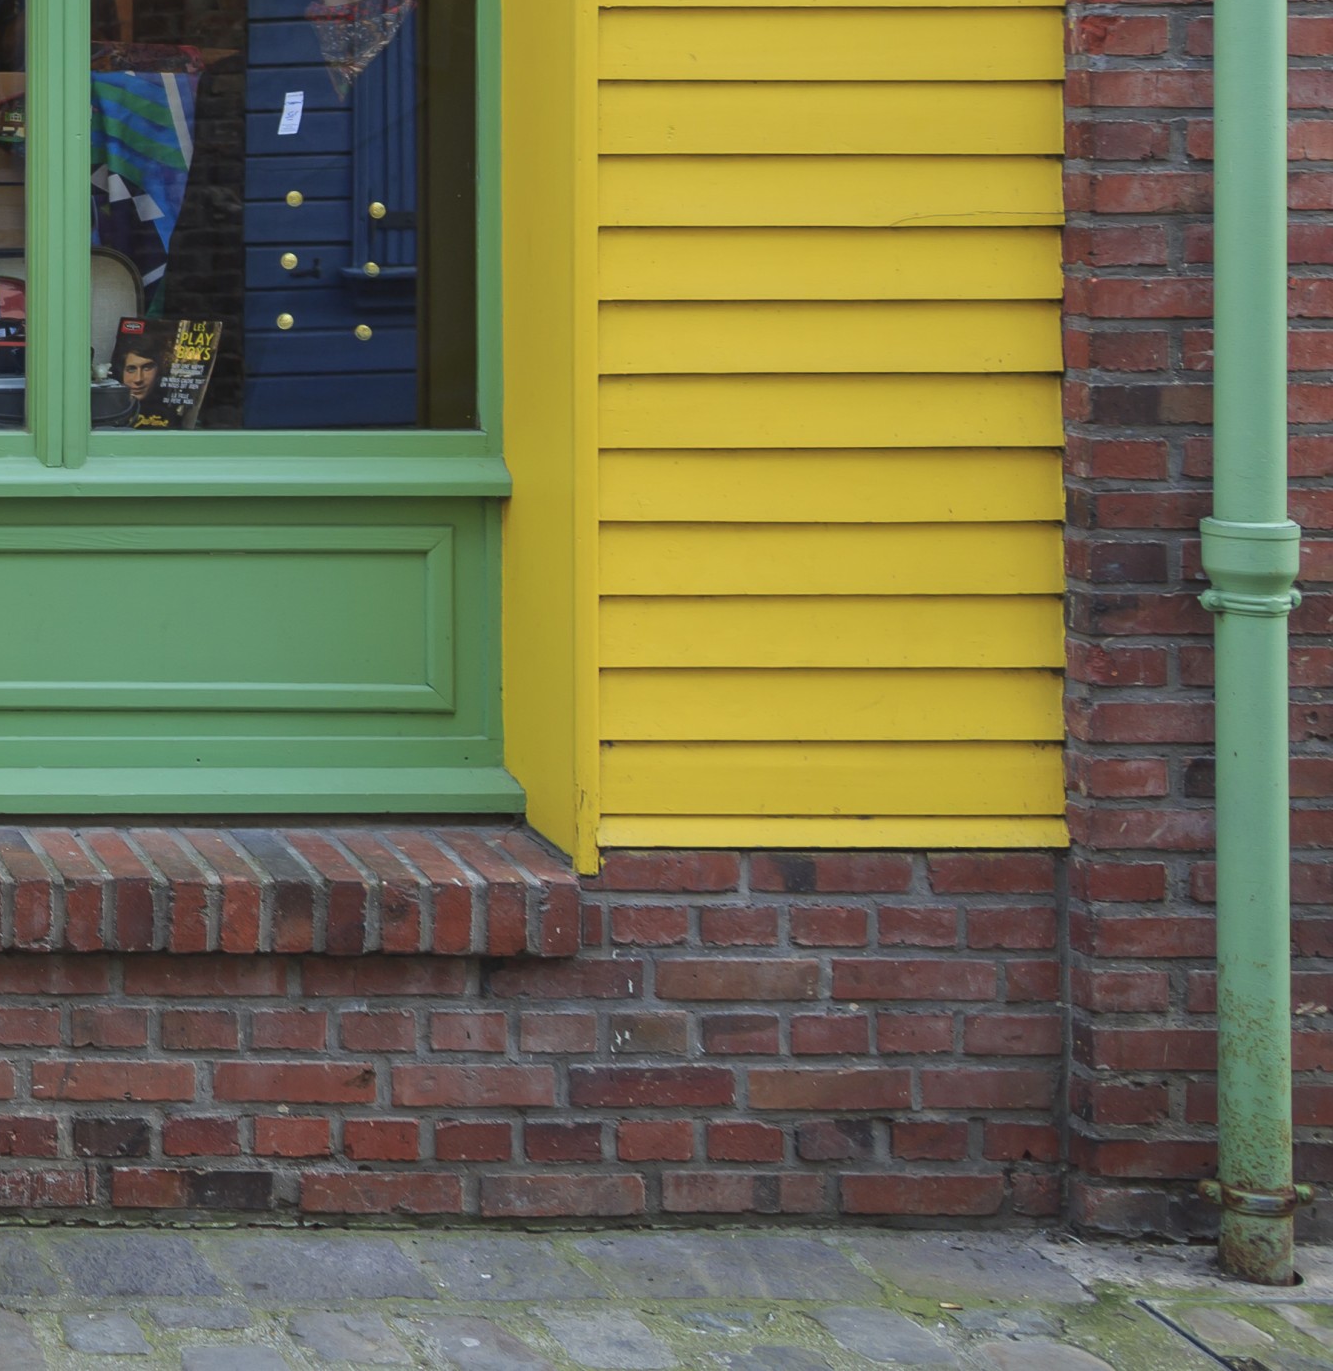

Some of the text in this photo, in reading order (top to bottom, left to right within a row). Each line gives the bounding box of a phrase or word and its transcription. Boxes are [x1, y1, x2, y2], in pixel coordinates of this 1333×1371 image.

[193, 322, 206, 332] LES
[180, 332, 214, 346] PLAY
[176, 347, 211, 361] BOYS
